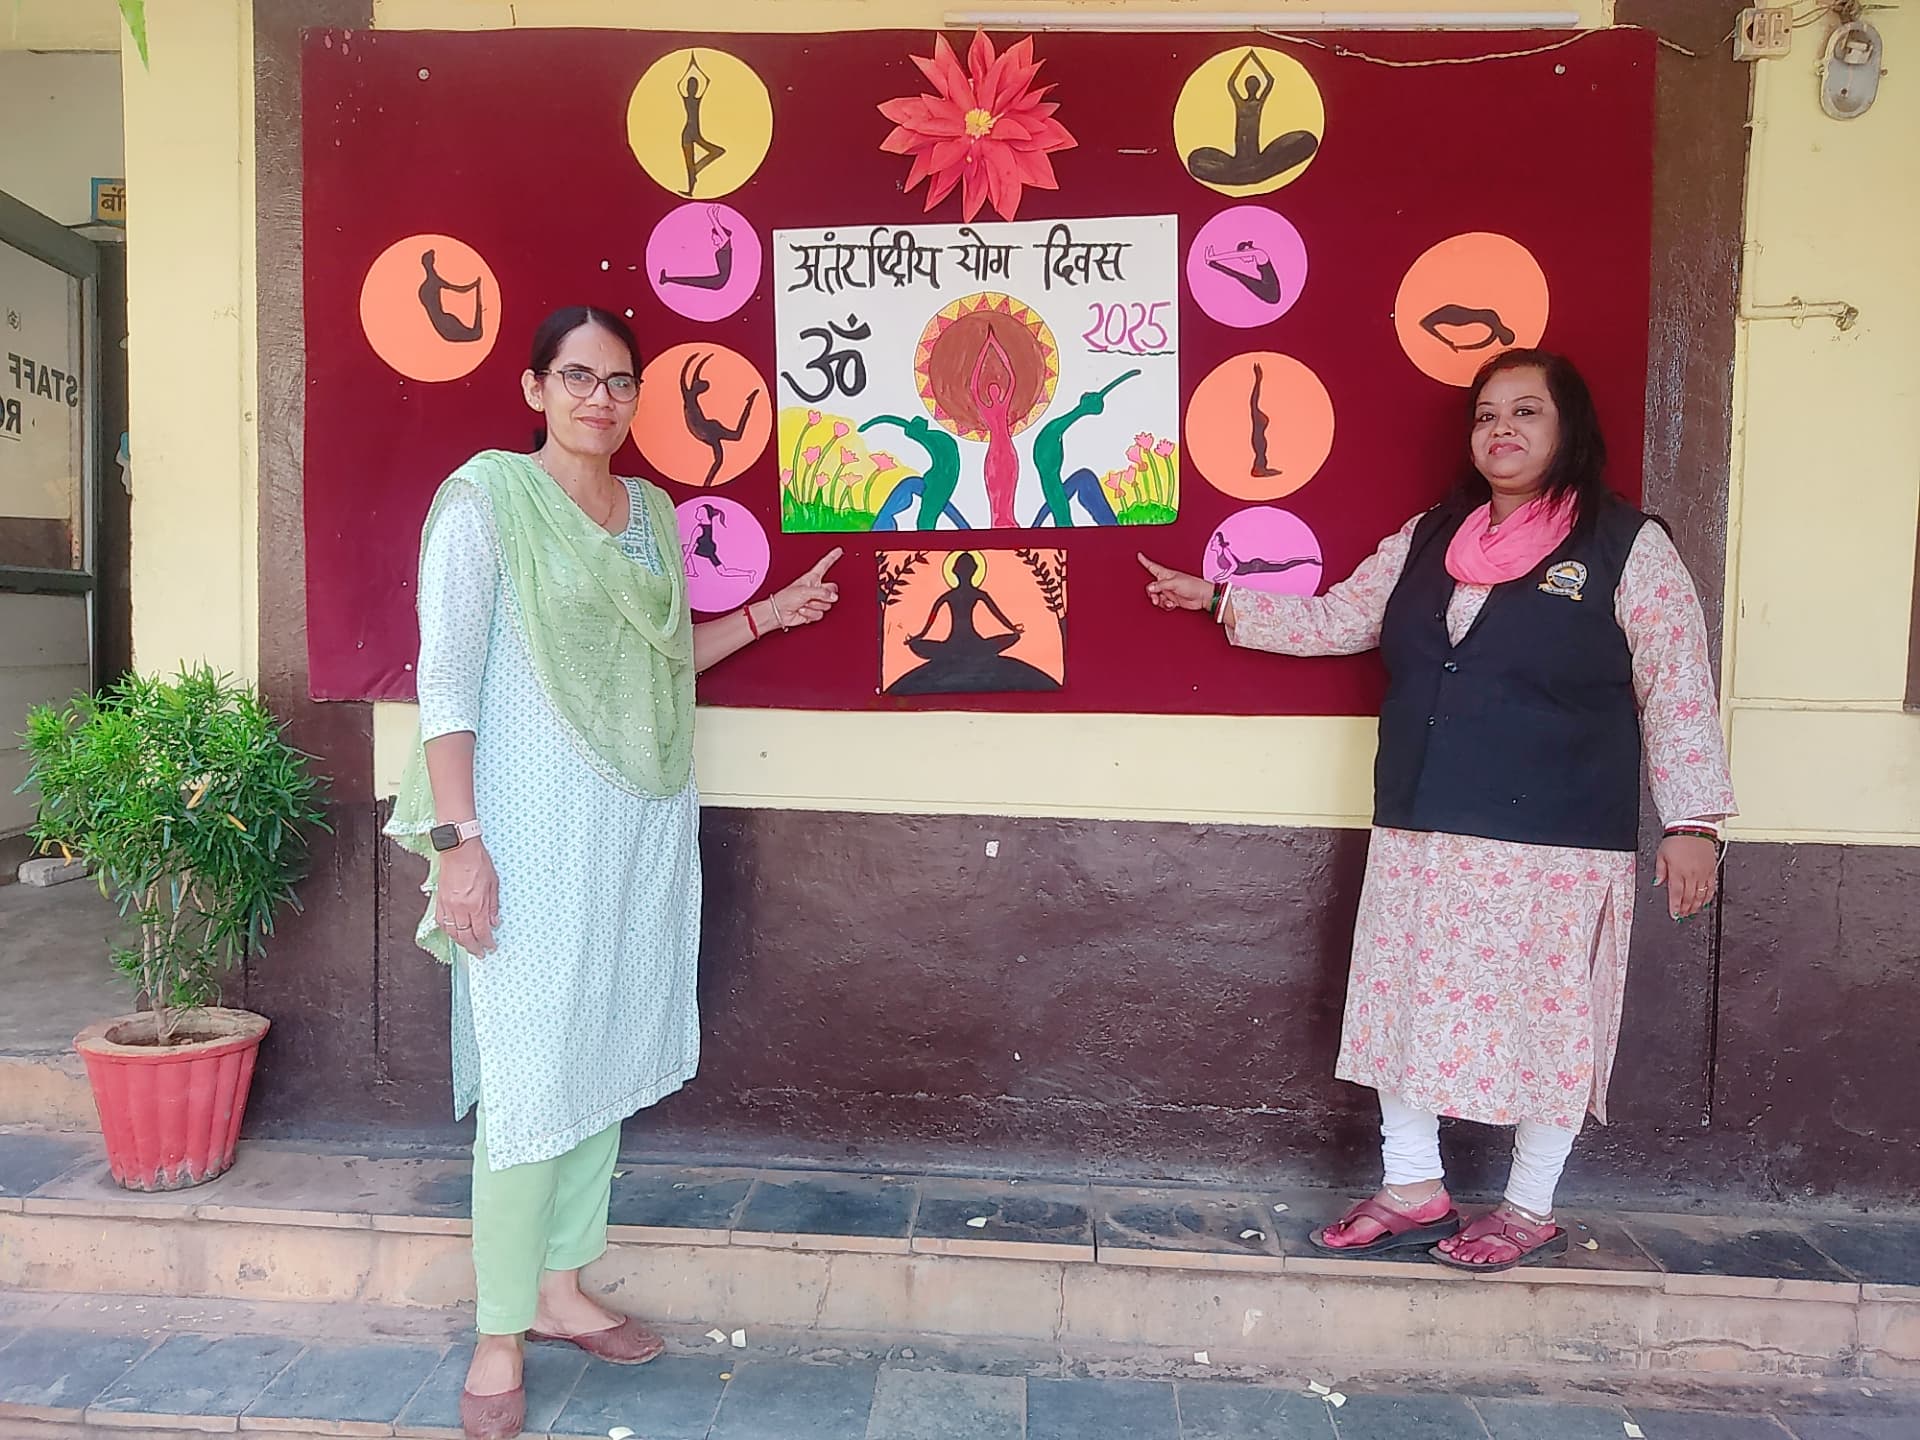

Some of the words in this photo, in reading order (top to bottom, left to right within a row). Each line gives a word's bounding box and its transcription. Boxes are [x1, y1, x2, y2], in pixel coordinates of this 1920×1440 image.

[947, 227, 1023, 282] योग
[1032, 223, 1133, 291] दिवस
[1082, 301, 1171, 353] 2025
